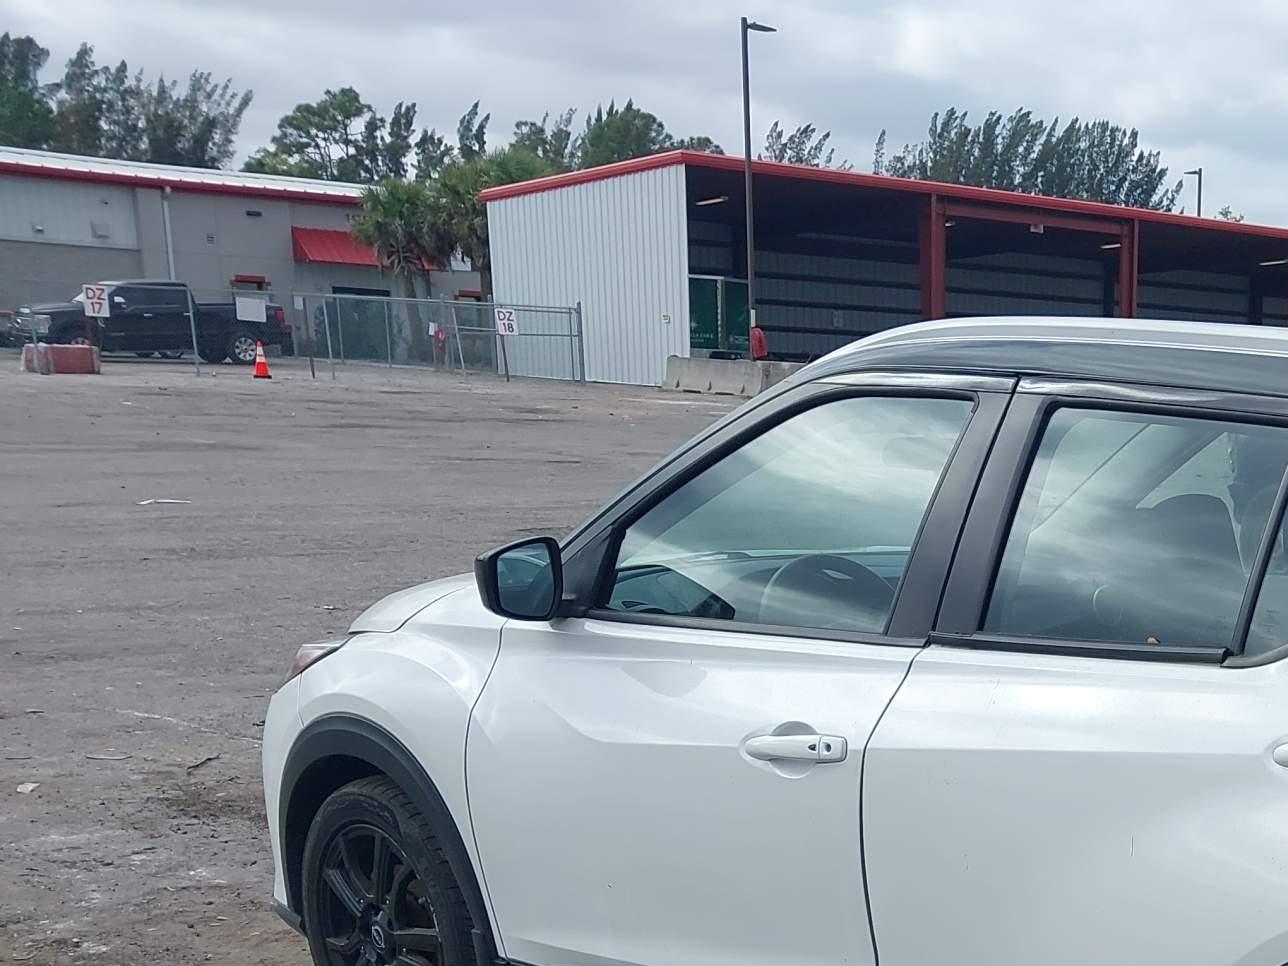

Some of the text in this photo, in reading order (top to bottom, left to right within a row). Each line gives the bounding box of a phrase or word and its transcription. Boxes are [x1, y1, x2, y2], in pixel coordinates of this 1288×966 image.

[86, 287, 106, 301] DZ
[91, 301, 103, 314] 17
[497, 310, 515, 322] DZ
[502, 322, 514, 333] 18
